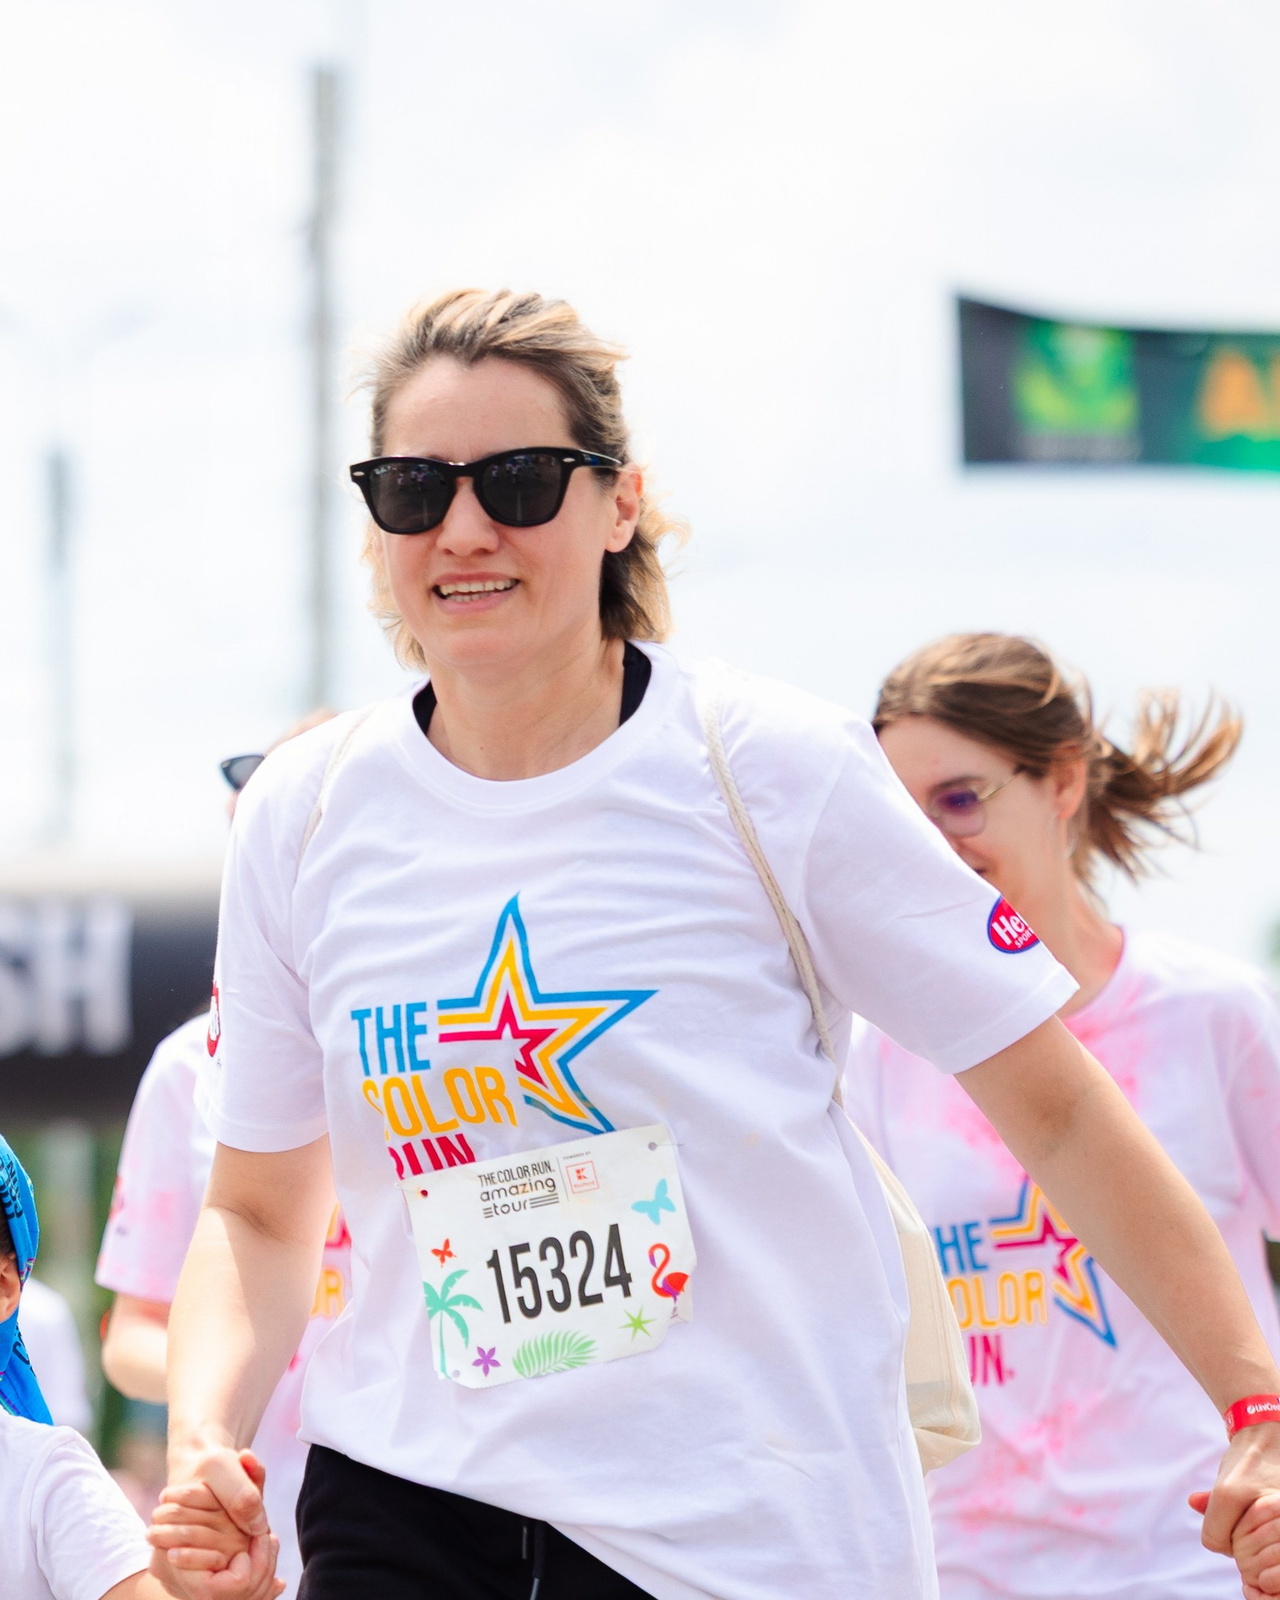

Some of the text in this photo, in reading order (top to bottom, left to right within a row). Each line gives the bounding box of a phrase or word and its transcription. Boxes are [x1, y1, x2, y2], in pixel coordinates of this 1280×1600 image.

[351, 1002, 431, 1077] THE
[477, 1172, 497, 1188] THE
[497, 1165, 532, 1184] COLOR
[480, 1177, 557, 1203] amazing
[493, 1199, 528, 1217] tour
[486, 1223, 633, 1324] 15324
[934, 1221, 988, 1275] HE
[946, 1270, 1048, 1331] OLOR
